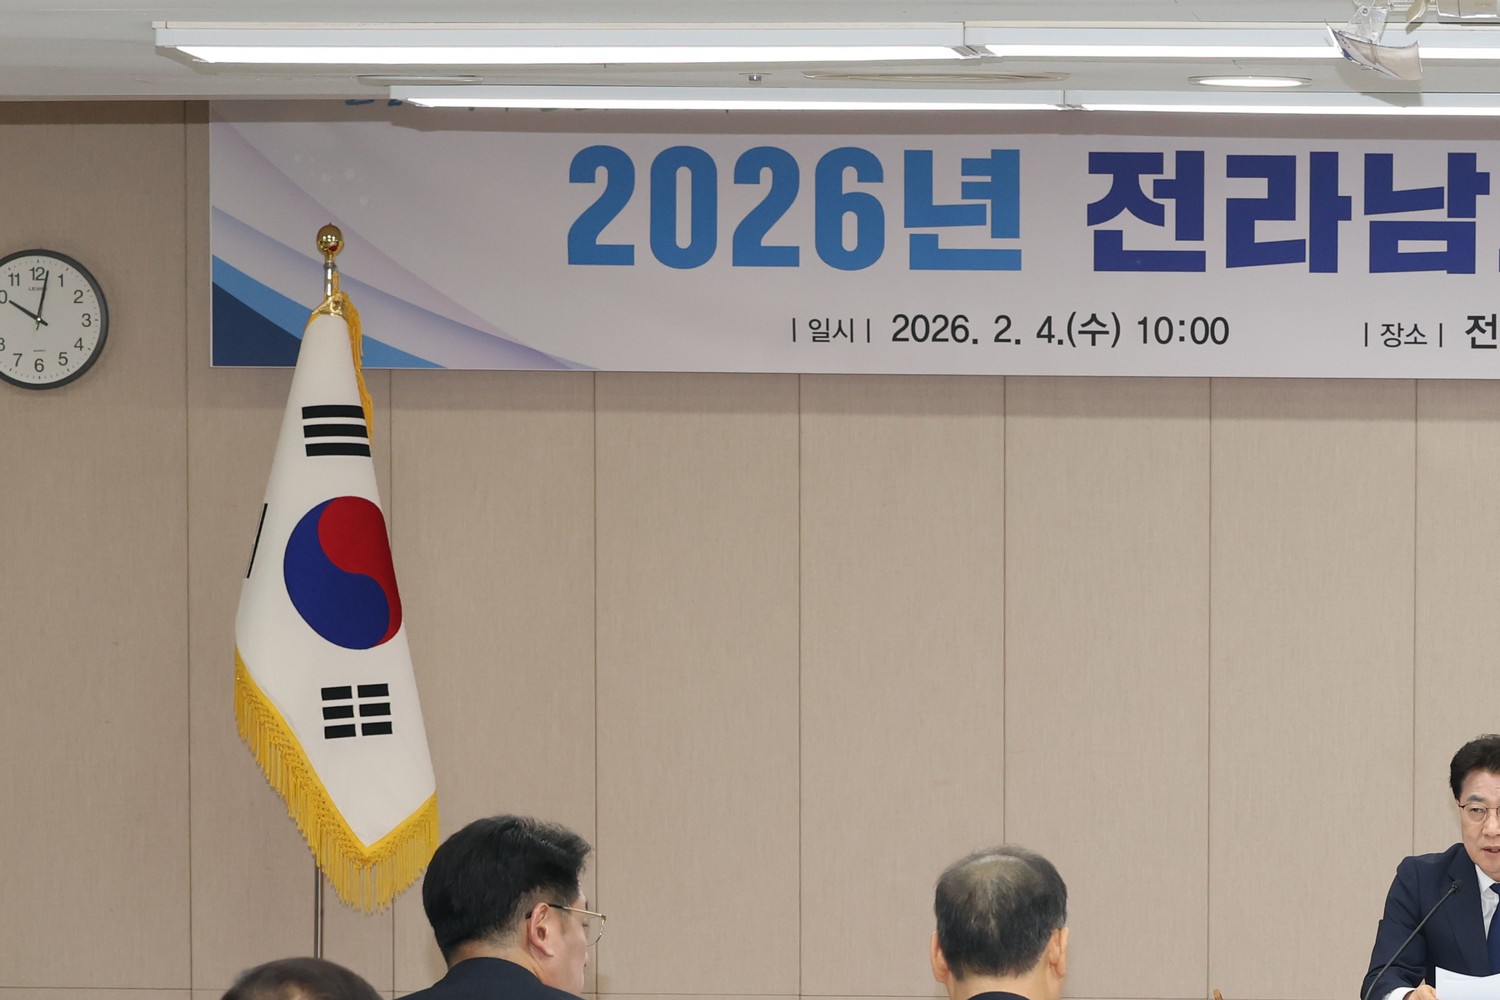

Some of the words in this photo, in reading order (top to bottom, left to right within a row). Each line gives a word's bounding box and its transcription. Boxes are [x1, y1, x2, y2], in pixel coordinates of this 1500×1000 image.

[567, 144, 1022, 271] 2026년
[891, 313, 979, 346] 2026.
[1137, 316, 1230, 346] 10:00
